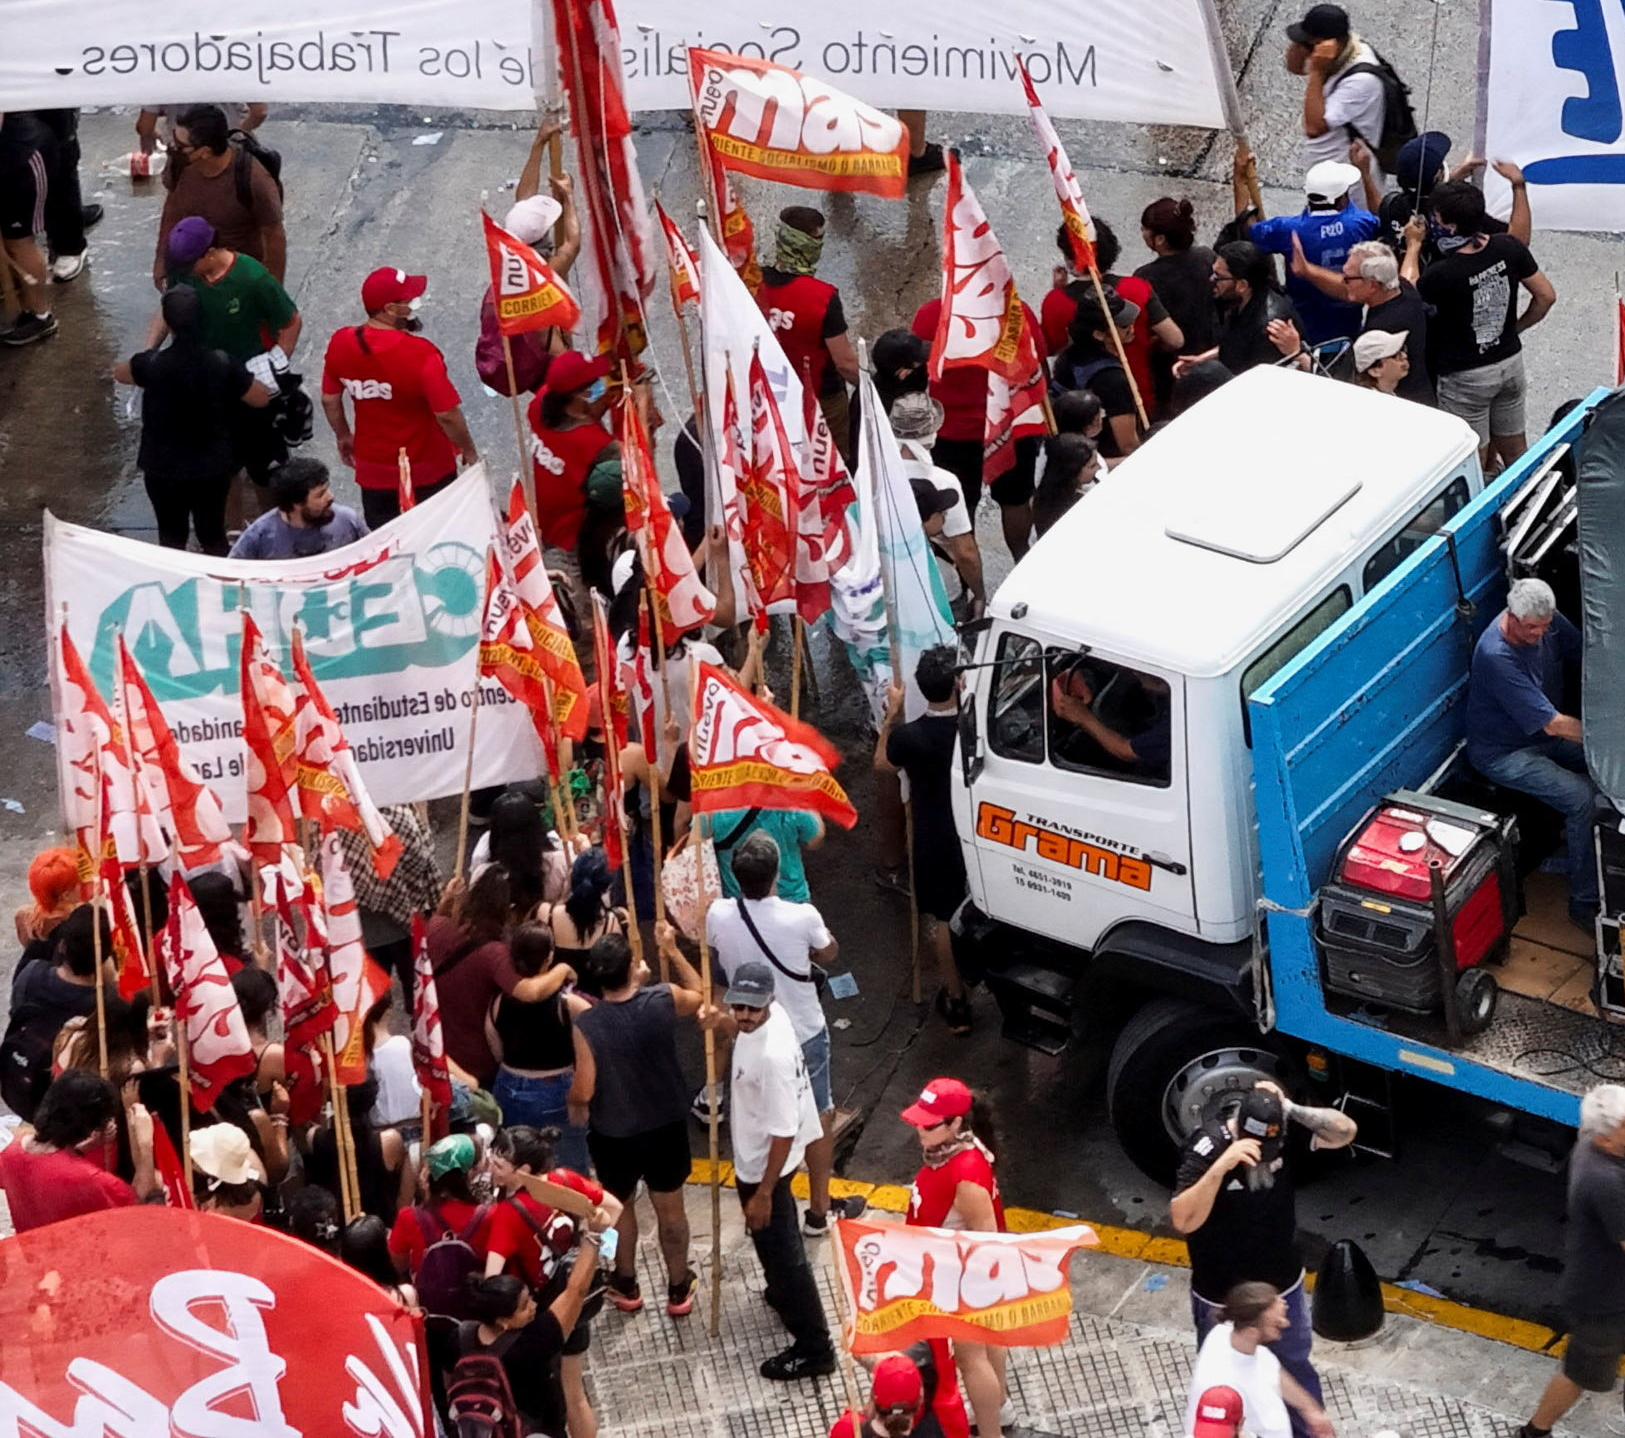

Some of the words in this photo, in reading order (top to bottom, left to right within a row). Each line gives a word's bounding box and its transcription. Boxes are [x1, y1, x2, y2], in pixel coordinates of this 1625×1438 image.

[343, 375, 394, 402] mas
[976, 799, 1155, 894] Grama
[1024, 811, 1142, 856] TRANSPORTE
